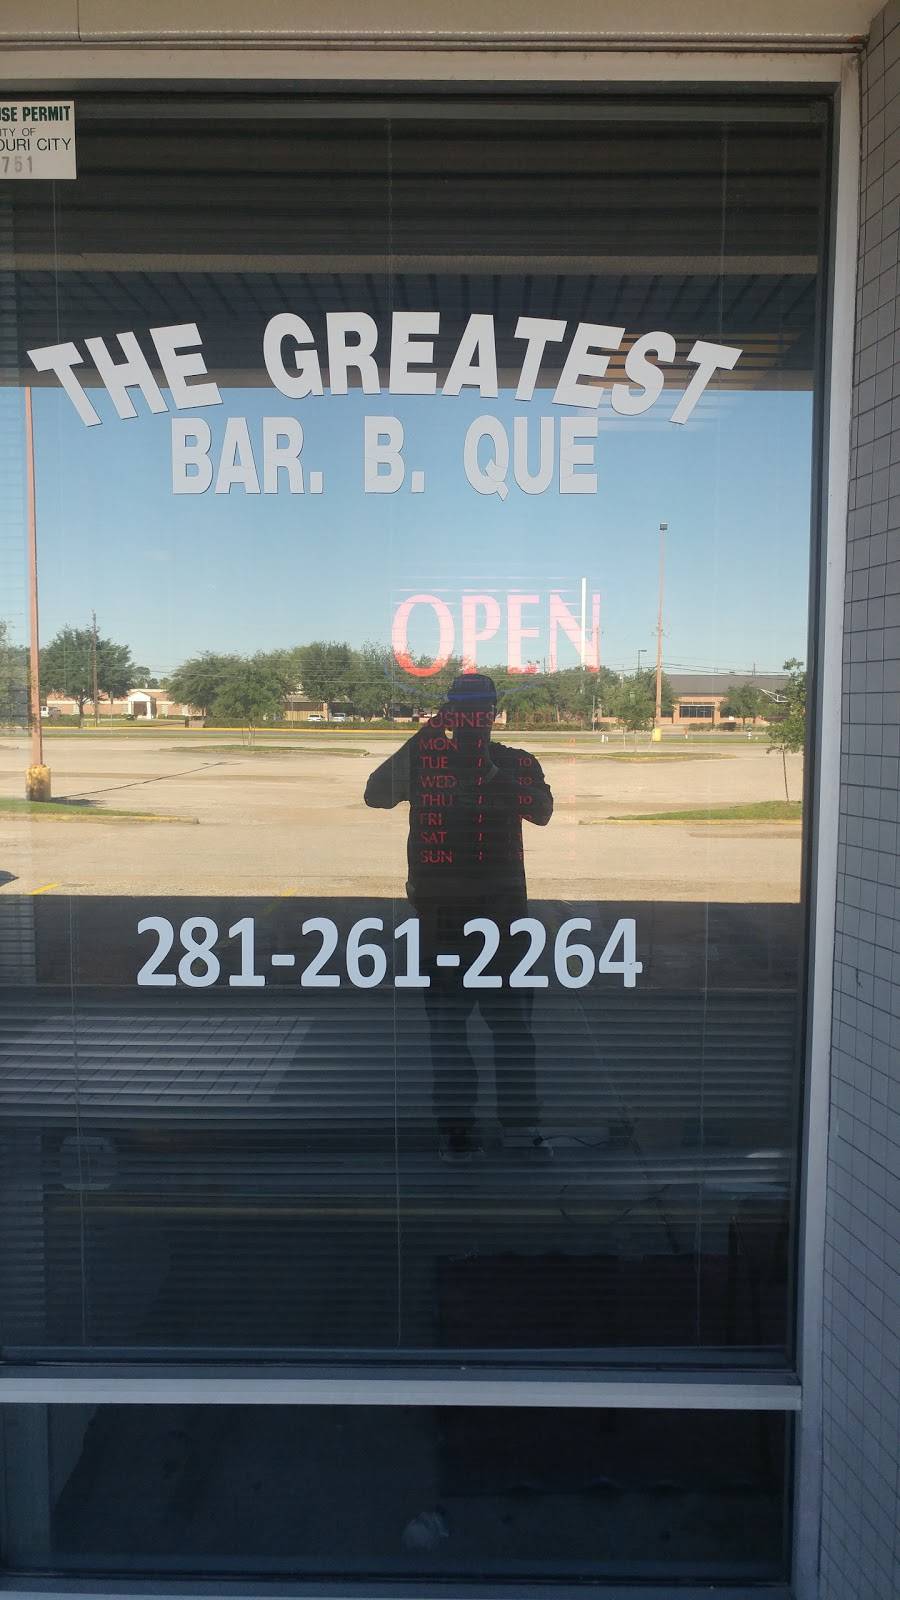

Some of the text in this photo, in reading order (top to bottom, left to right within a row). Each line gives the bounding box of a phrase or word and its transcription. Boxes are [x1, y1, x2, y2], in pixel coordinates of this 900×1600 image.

[0, 105, 70, 121] SE PERMIT
[21, 127, 36, 137] OF
[0, 138, 71, 152] OURI CITY
[27, 312, 742, 427] THE GREATEST
[171, 415, 598, 501] BAR. B. QUE
[392, 593, 601, 677] OPEN
[420, 737, 458, 751] MON
[420, 756, 448, 768] TUE
[421, 775, 457, 788] WED
[421, 793, 454, 806] THU
[420, 812, 442, 825] FRI
[421, 831, 447, 843] SAT
[421, 850, 453, 863] SUN
[136, 916, 643, 989] 281-261-2264
